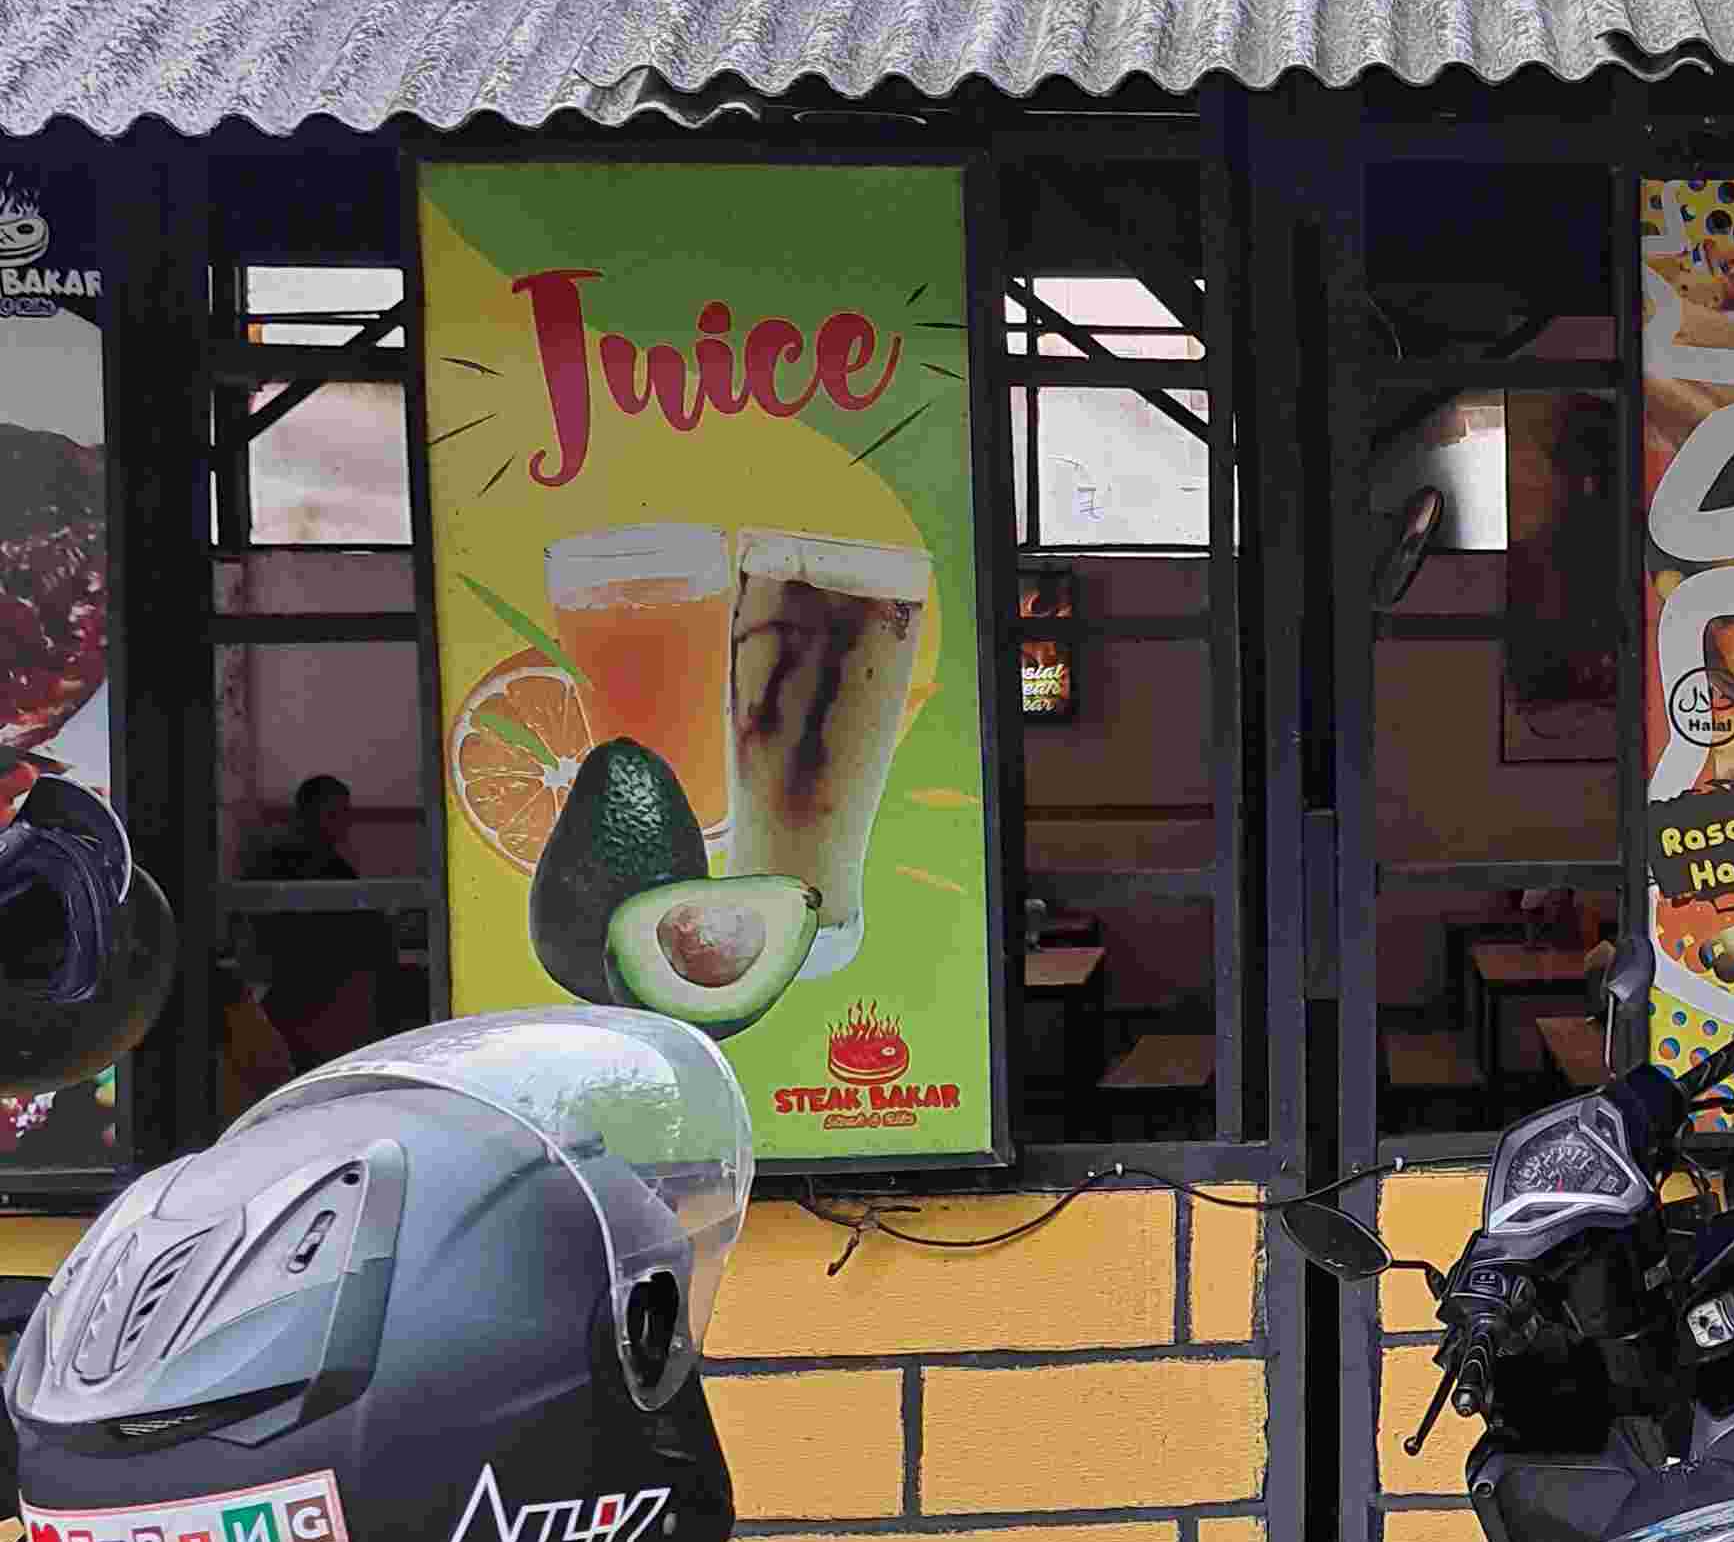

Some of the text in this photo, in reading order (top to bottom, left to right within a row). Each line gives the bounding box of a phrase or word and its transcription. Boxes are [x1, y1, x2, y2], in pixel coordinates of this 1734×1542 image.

[511, 268, 902, 488] Juice
[1688, 717, 1732, 732] Halal
[774, 1084, 961, 1114] STEAK BAKAR
